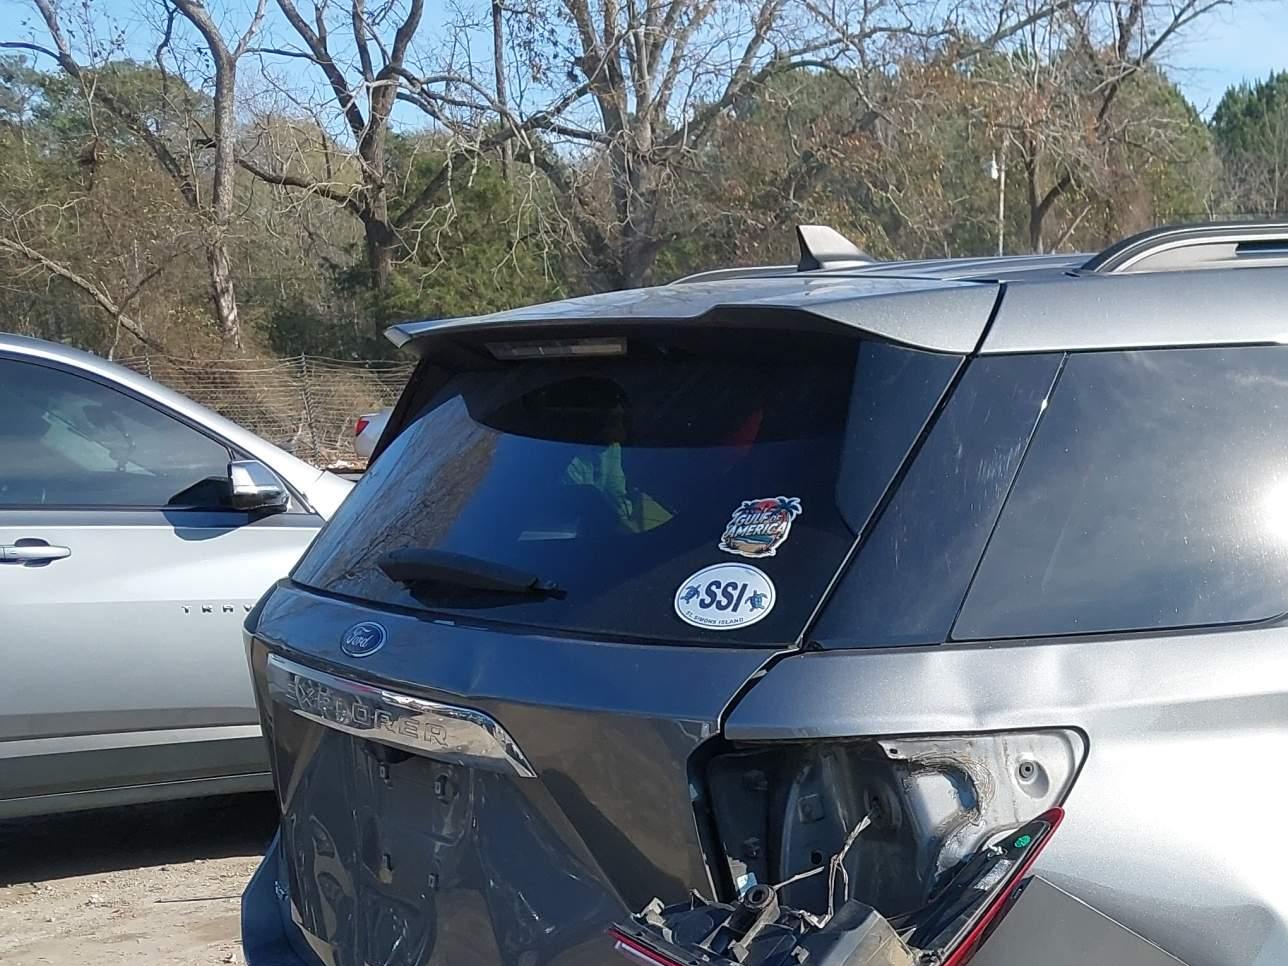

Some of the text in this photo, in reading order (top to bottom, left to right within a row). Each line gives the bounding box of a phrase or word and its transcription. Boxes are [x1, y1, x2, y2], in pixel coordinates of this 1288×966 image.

[736, 512, 771, 526] GULF
[726, 522, 786, 538] AMERICA
[699, 580, 748, 612] SSI
[718, 617, 744, 625] ISLAND
[345, 625, 373, 649] Ford
[286, 675, 449, 747] EXPLORER
